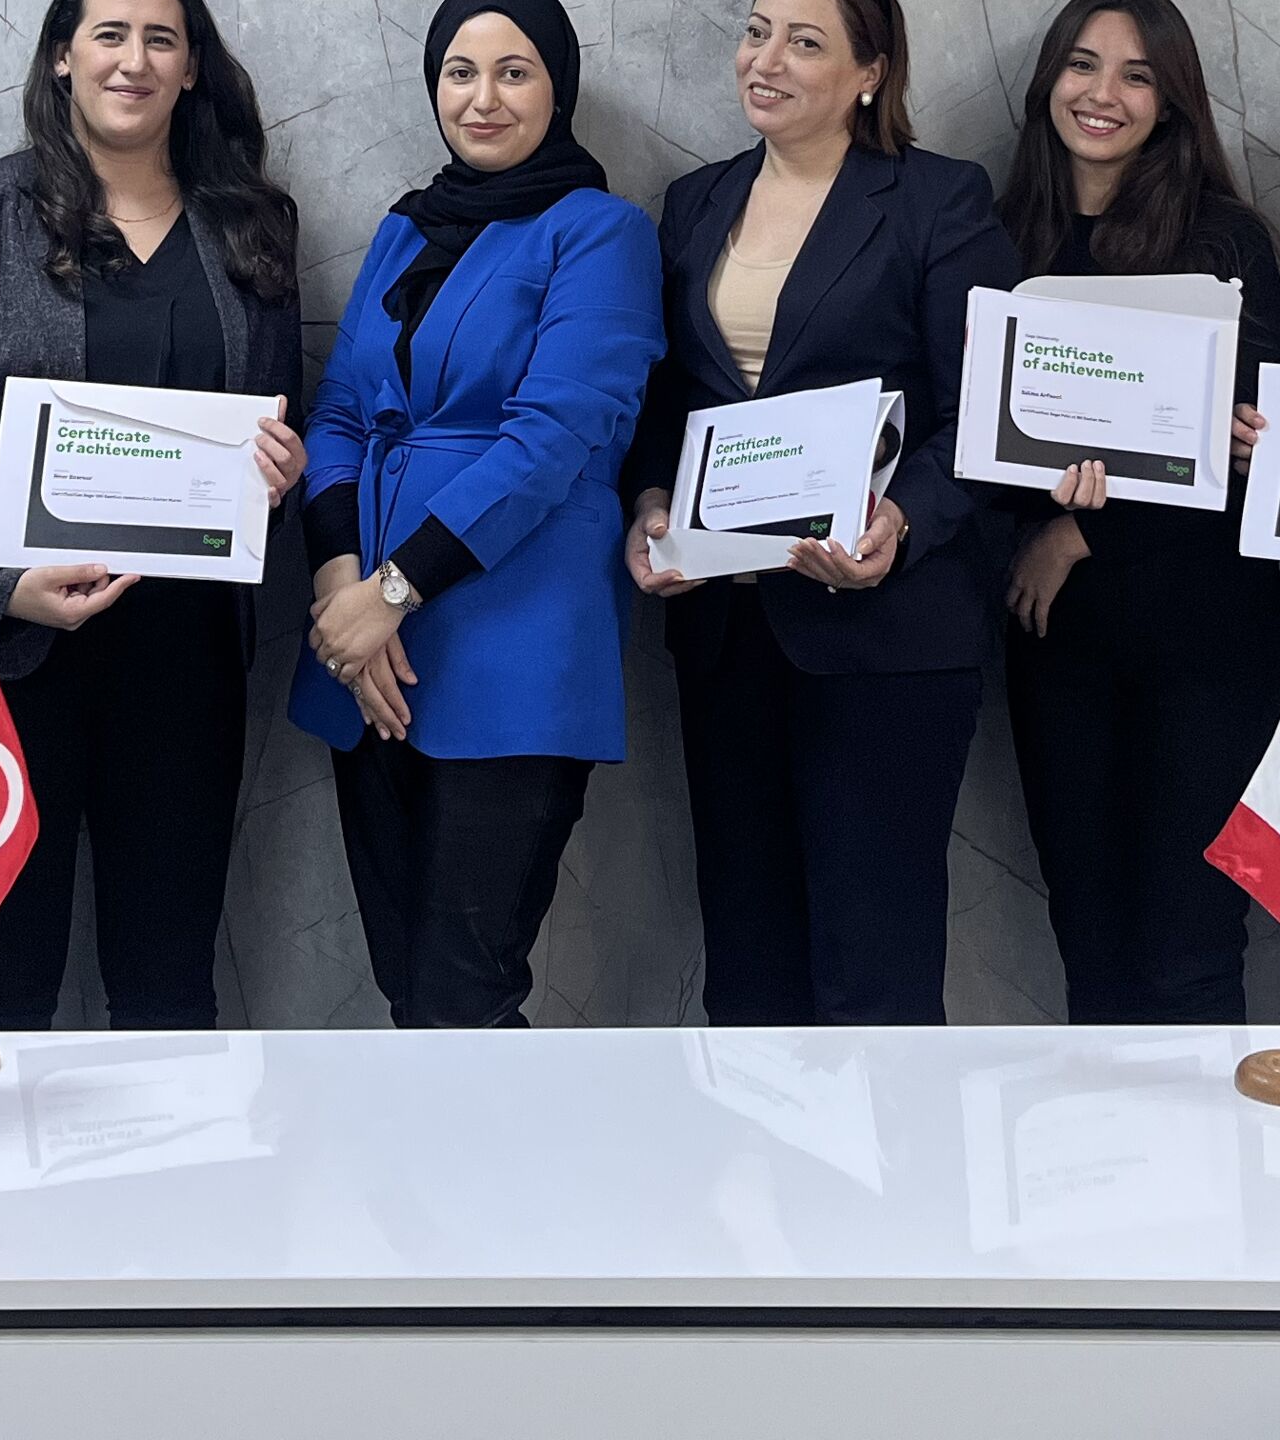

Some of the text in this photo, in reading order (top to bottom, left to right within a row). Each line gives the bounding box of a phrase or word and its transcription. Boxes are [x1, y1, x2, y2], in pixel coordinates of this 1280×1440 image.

[1024, 342, 1114, 364] Certificate
[1023, 358, 1145, 383] of achievement
[58, 427, 151, 443] Certificate
[56, 441, 183, 460] of achievement
[716, 435, 782, 455] Certificate
[713, 444, 804, 469] of achievement
[1166, 461, 1190, 477] Sage
[202, 534, 226, 549] Sage
